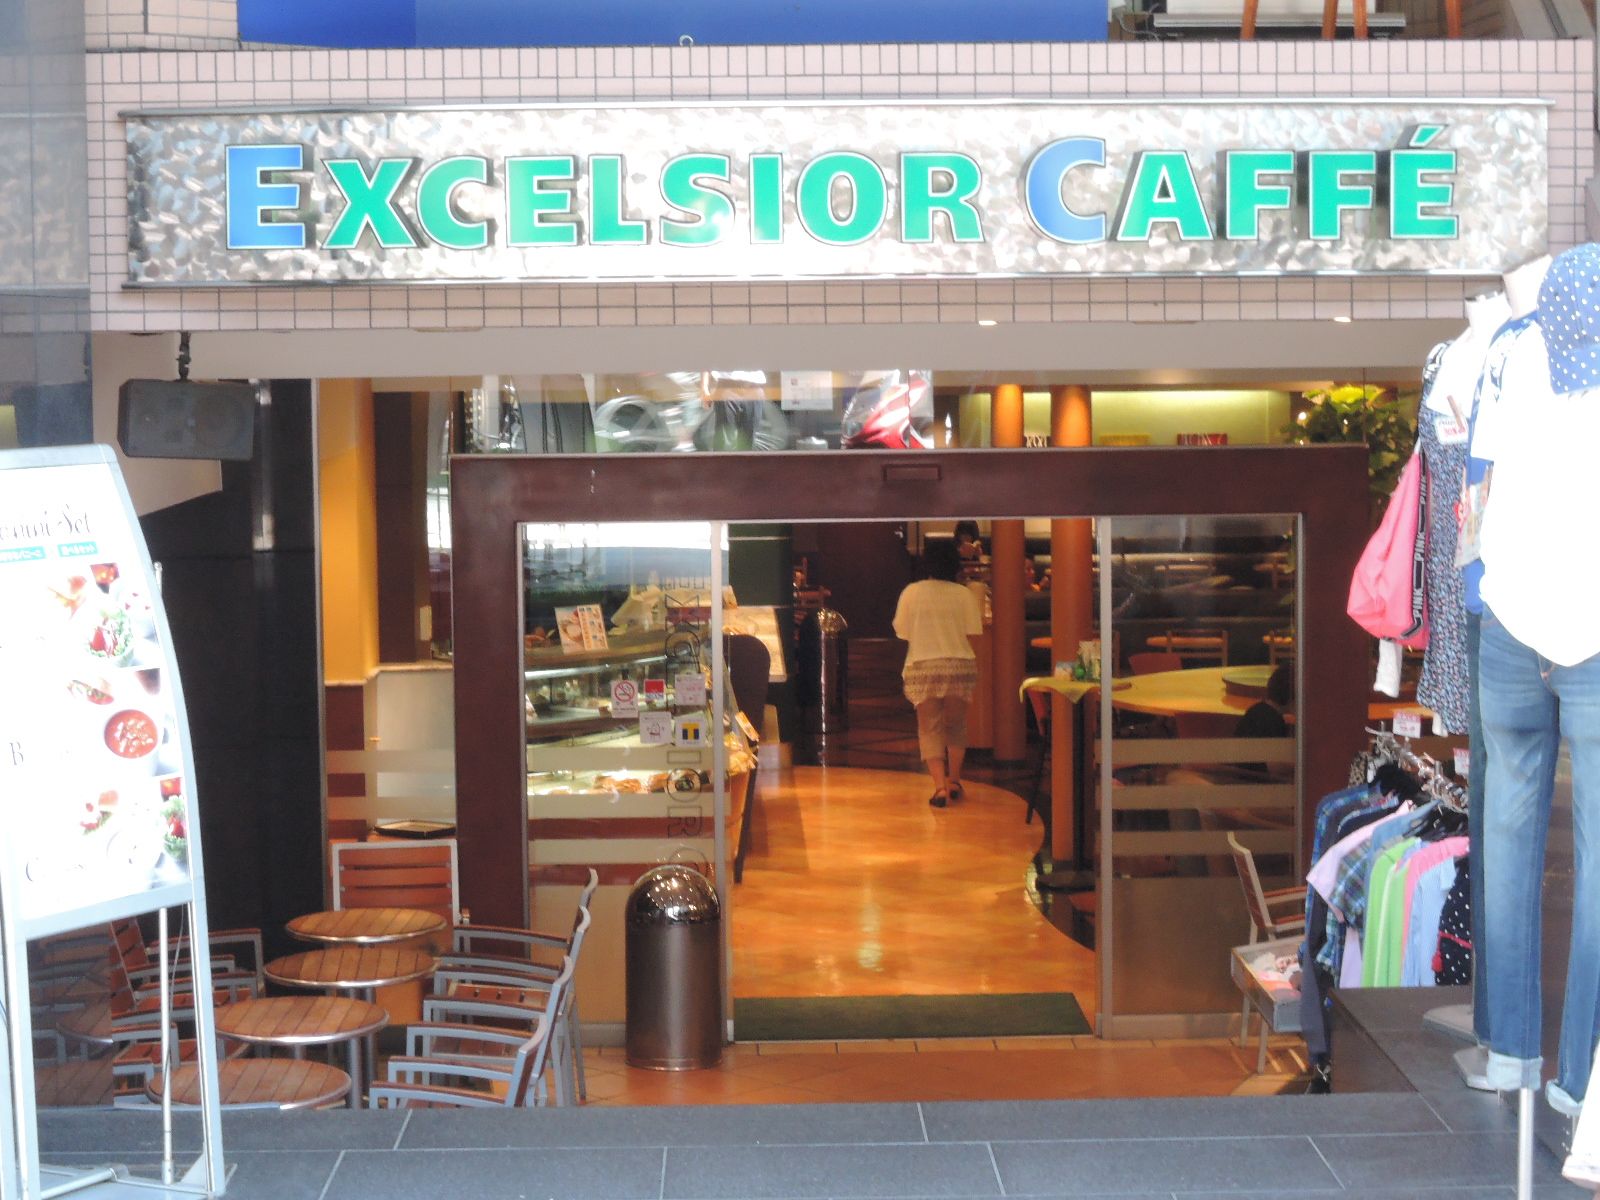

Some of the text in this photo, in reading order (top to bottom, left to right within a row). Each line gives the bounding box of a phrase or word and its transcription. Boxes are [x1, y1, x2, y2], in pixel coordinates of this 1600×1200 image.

[225, 125, 1460, 250] EXCELSIOR CAFFÉ
[1414, 532, 1426, 561] PINK
[1412, 589, 1423, 618] PINK
